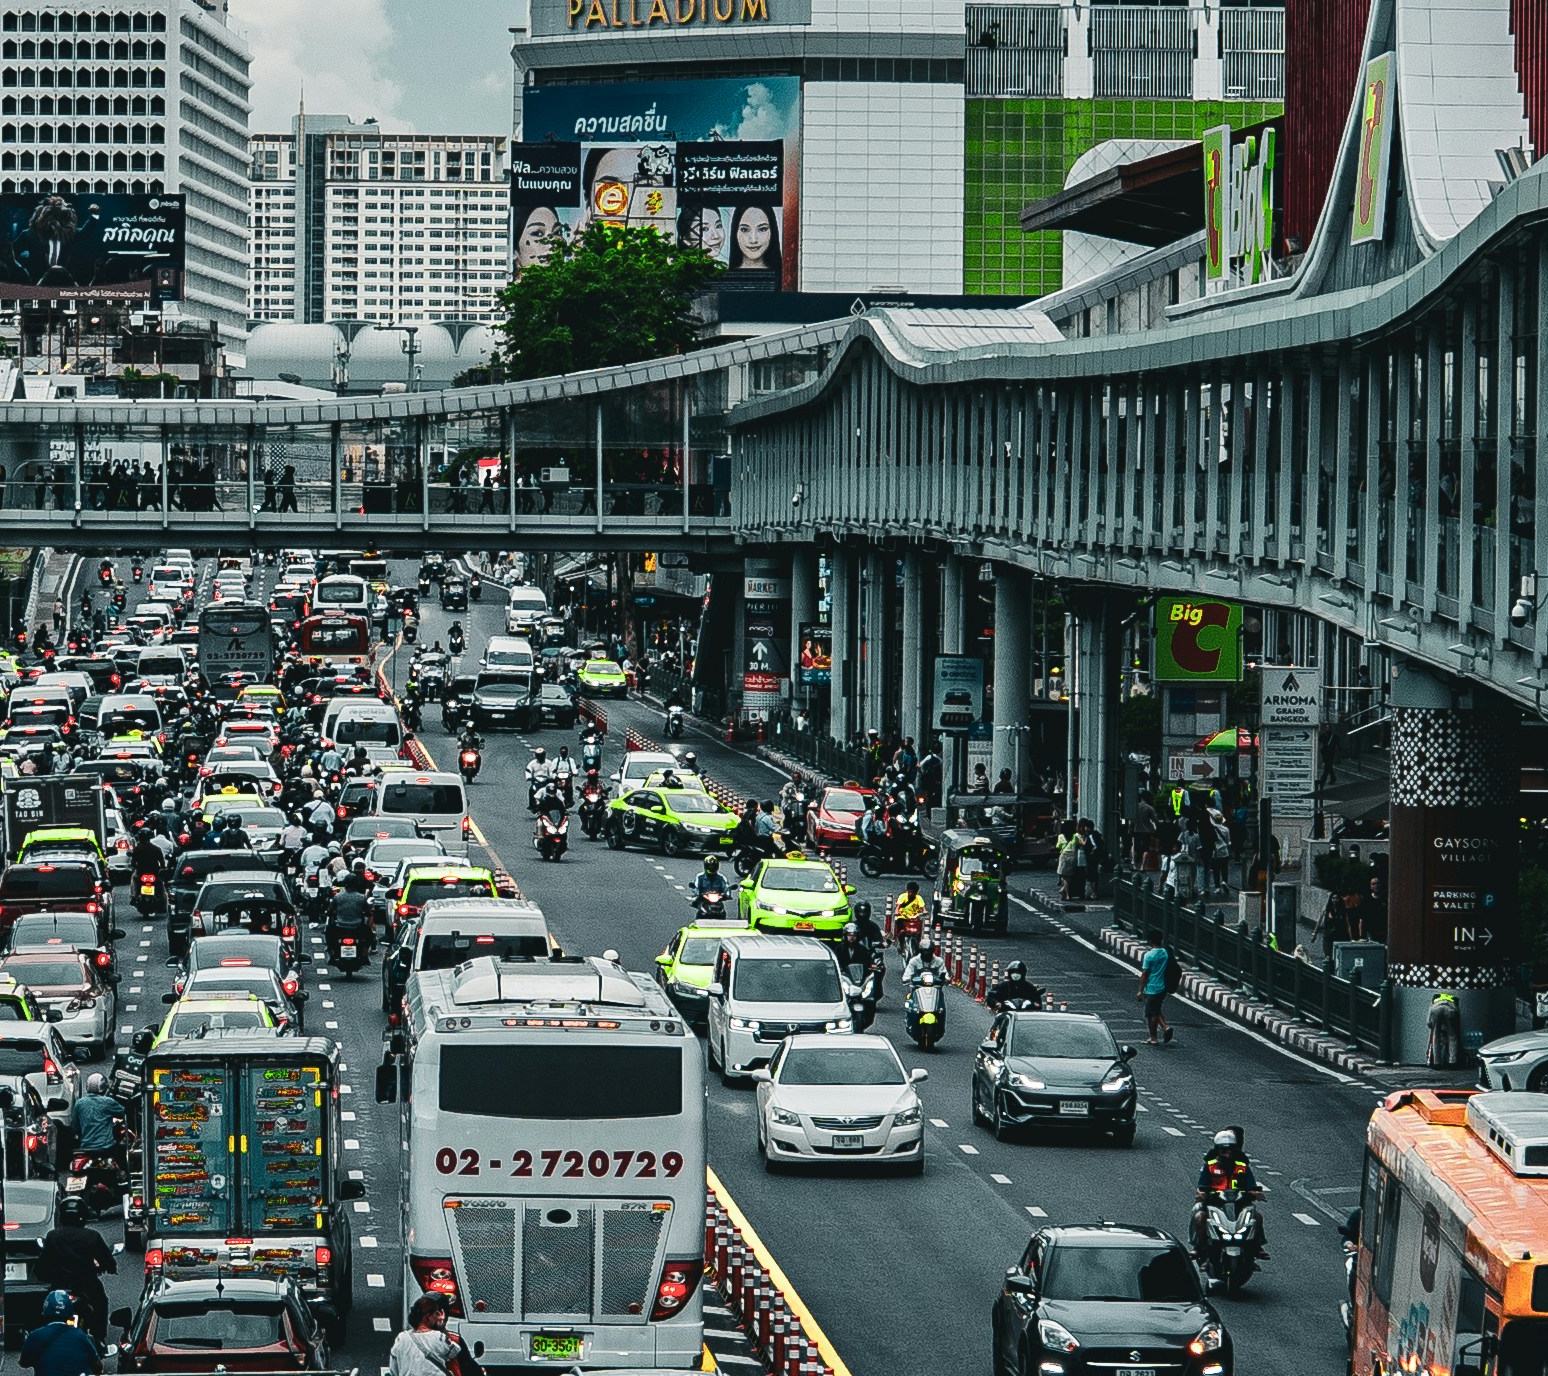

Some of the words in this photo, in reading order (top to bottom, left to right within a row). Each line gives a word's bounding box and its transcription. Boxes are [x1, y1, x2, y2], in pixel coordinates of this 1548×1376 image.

[574, 102, 667, 134] ความสดชื่น
[517, 176, 572, 193] ในแบบคุณ
[1170, 605, 1203, 626] Big
[1264, 696, 1317, 706] ARNOMA
[1433, 891, 1477, 899] PARKING
[1443, 901, 1476, 909] VALET
[1453, 927, 1475, 942] IN
